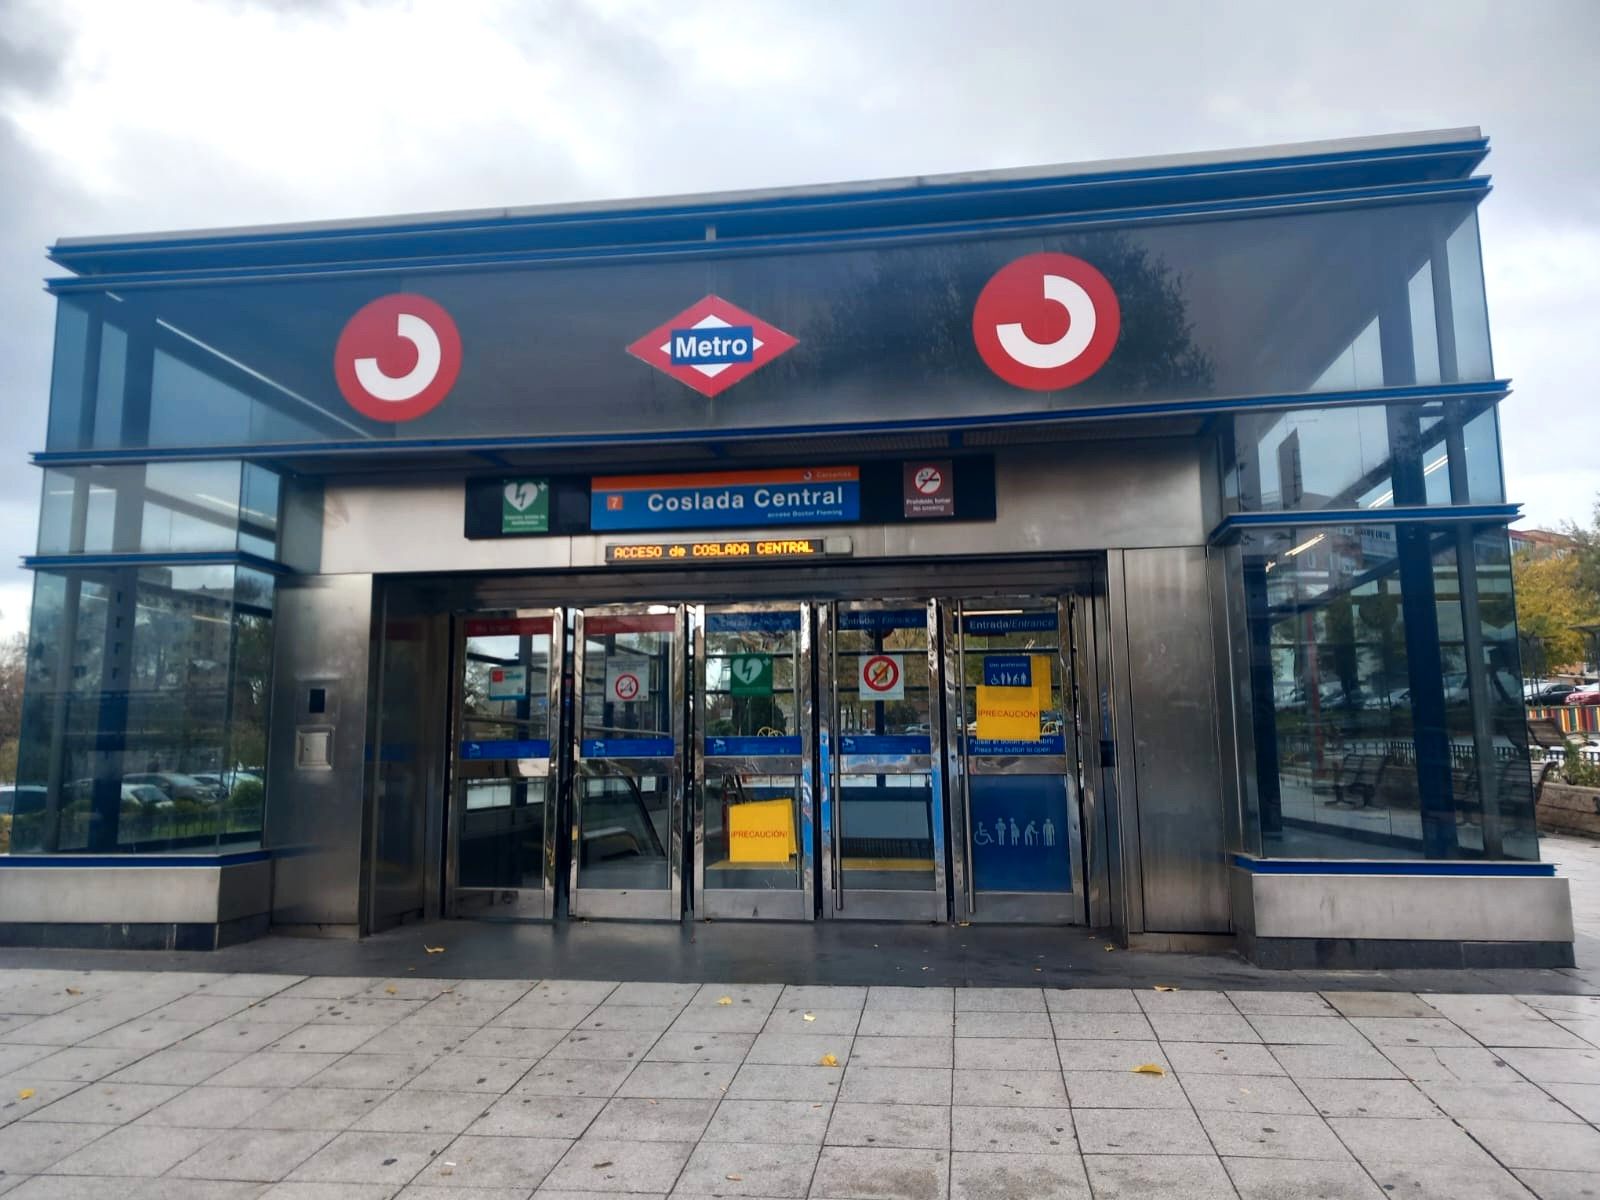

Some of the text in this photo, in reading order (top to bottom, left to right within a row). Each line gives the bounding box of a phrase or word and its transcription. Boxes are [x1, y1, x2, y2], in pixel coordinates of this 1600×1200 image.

[675, 336, 748, 358] Metro
[611, 497, 618, 508] 7
[648, 486, 843, 512] Coslada Central
[614, 541, 814, 559] ACCESO de COSLADA CENTRAL
